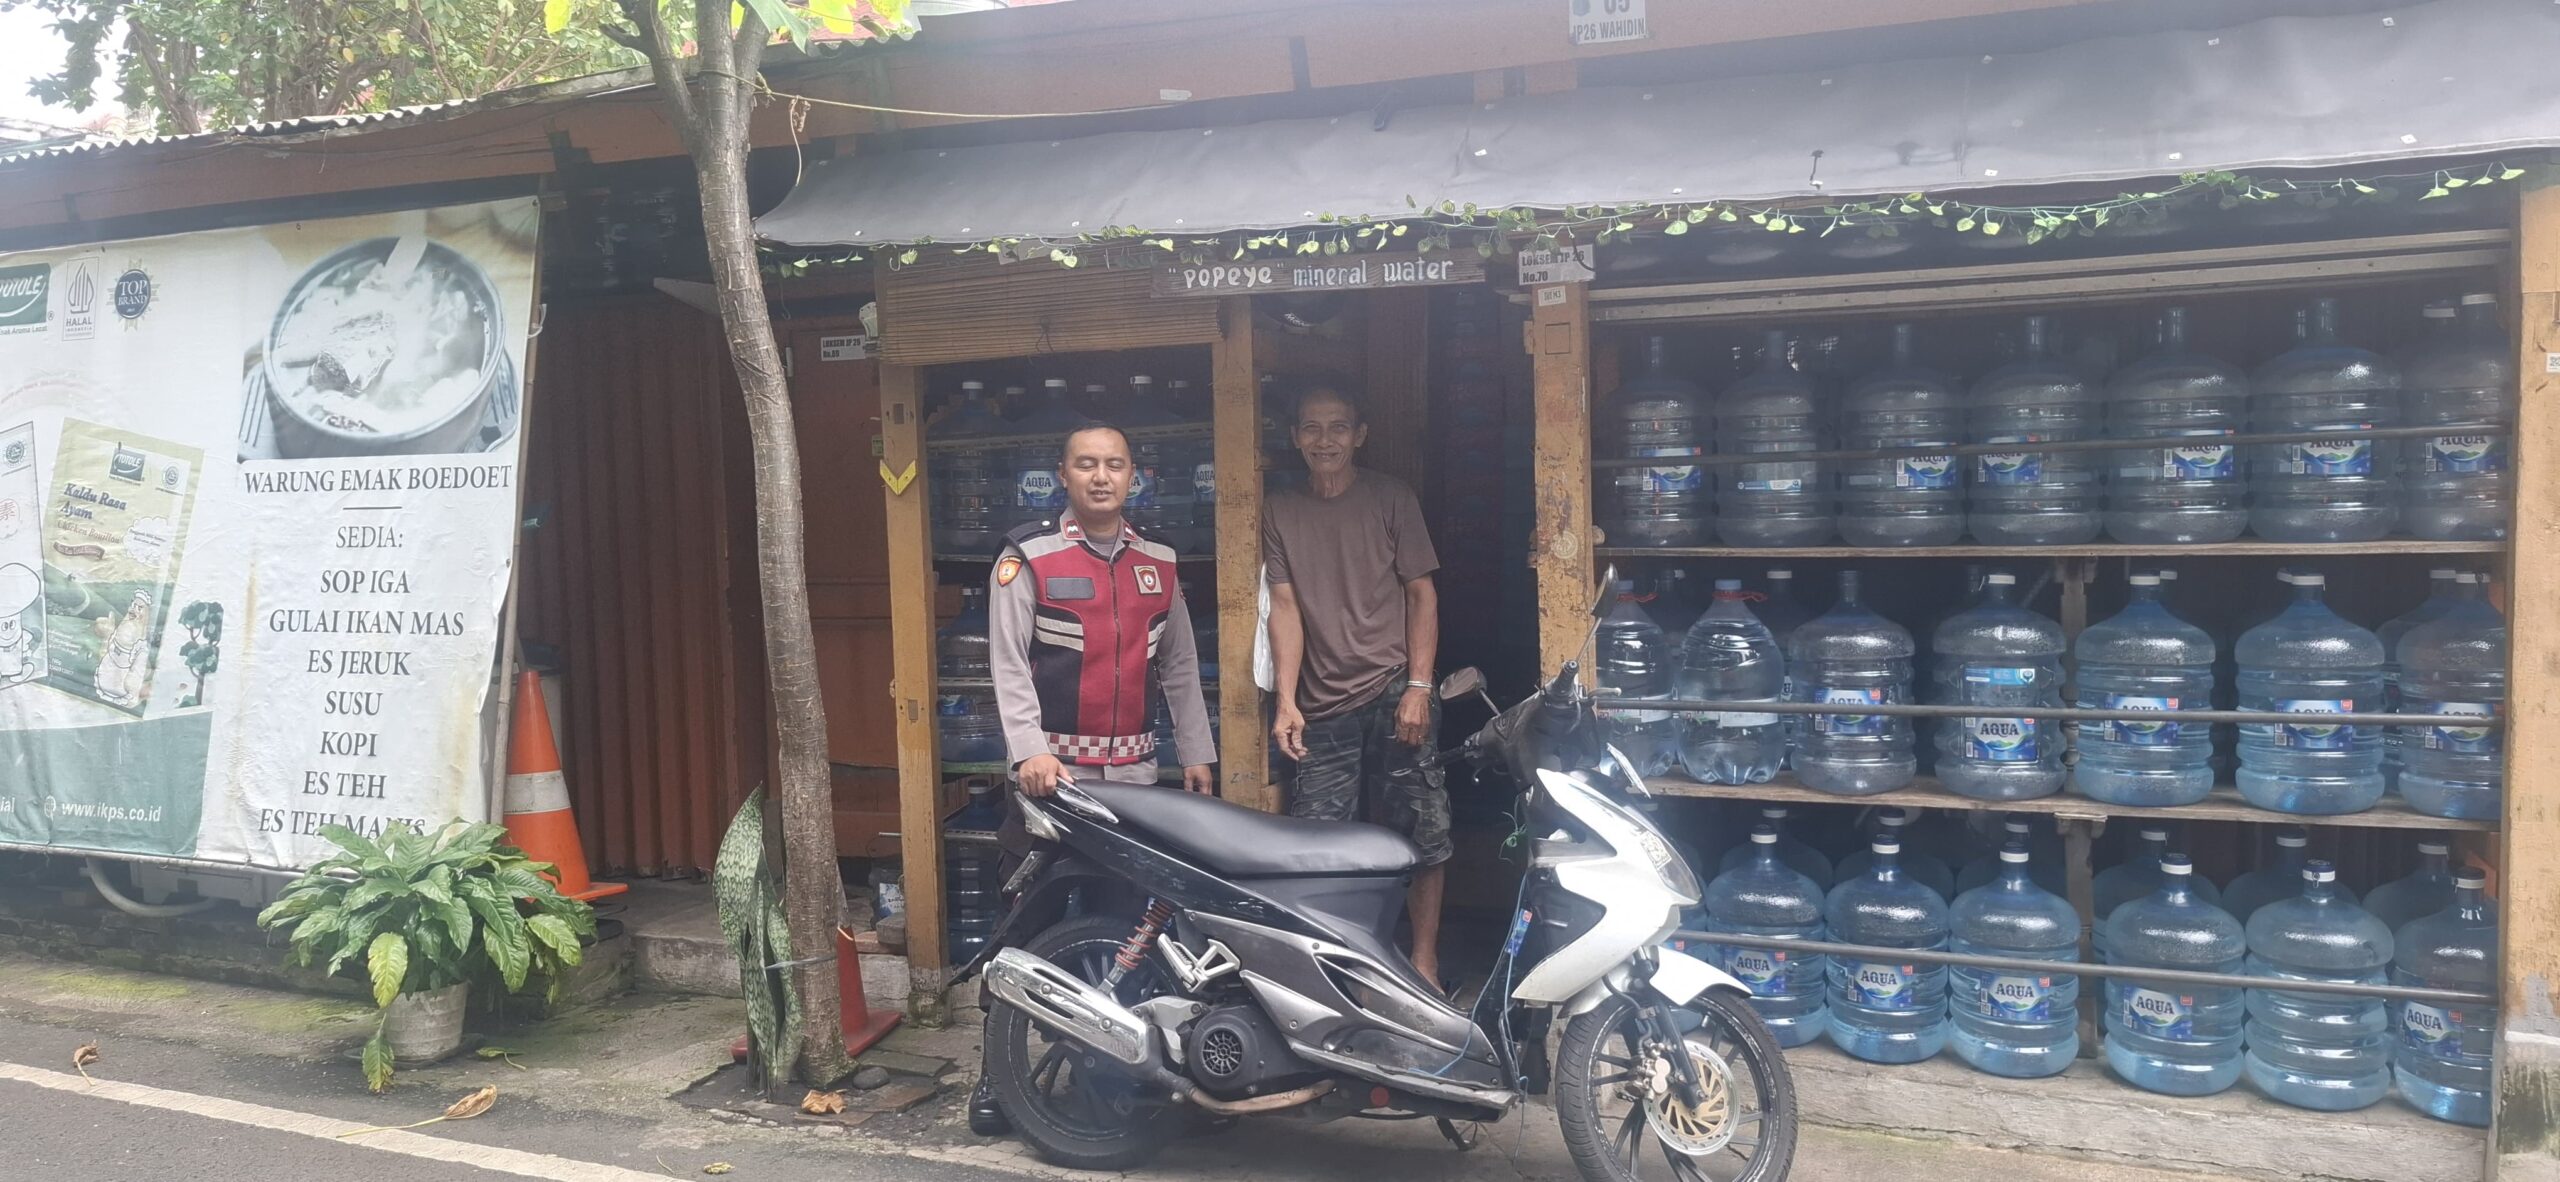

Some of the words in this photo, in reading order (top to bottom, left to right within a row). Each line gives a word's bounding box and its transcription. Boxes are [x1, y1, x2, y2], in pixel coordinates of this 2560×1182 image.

[1599, 18, 1645, 39] WAHIDIN
[1293, 260, 1368, 287] mineral
[1383, 257, 1454, 282] water
[1522, 271, 1549, 283] No.70
[0, 275, 44, 297] OTOLE
[119, 280, 148, 296] TOP
[118, 295, 148, 306] BRAND
[66, 316, 93, 326] HALAL
[244, 470, 334, 493] WARUNG
[339, 468, 403, 491] EMAK
[407, 465, 512, 490] BOEDOET
[1025, 476, 1052, 489] AQUA
[63, 482, 98, 503] Kaldu
[98, 491, 128, 511] Rasa
[60, 500, 93, 519] Ayam
[336, 526, 404, 549] SEDIA:
[320, 570, 365, 593] SOP
[369, 570, 411, 594] IGA
[269, 609, 340, 633] GULAI
[346, 610, 403, 634] IKAN
[411, 611, 464, 636] MAS
[306, 650, 333, 673] ES
[337, 650, 411, 679] JERUK
[324, 690, 383, 716] SUSU
[1980, 723, 2019, 738] AQUA
[320, 731, 378, 757] KOPI
[302, 770, 330, 796] ES
[336, 772, 387, 799] TEH
[61, 801, 162, 822] www.ikps.co.id
[259, 808, 285, 833] ES
[1736, 955, 1771, 973] AQUA
[1860, 969, 1898, 986] AQUA
[1995, 983, 2034, 999] AQUA
[2135, 996, 2175, 1015] AQUA
[2406, 1008, 2443, 1031] AQUA
